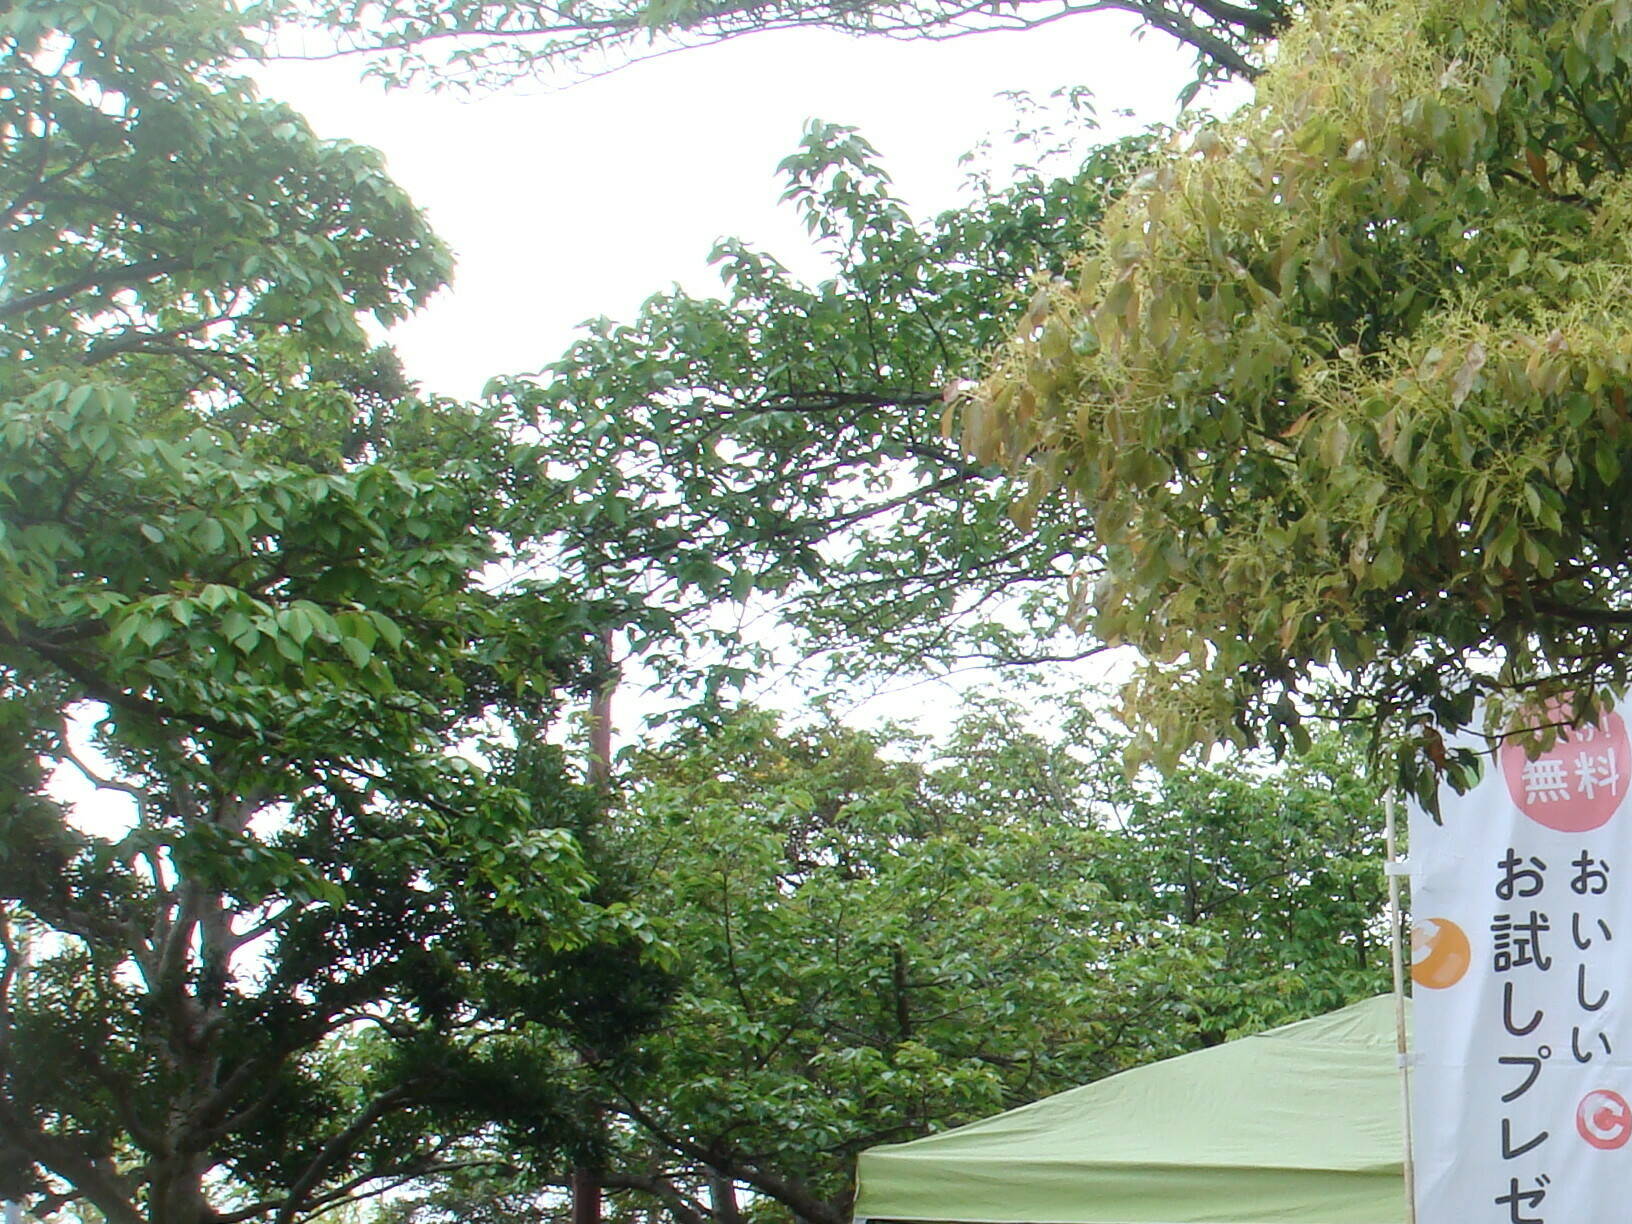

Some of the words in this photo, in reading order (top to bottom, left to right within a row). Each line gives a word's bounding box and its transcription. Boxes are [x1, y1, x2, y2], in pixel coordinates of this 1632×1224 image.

[1522, 747, 1620, 805] 無料
[1570, 849, 1612, 1064] おいしい
